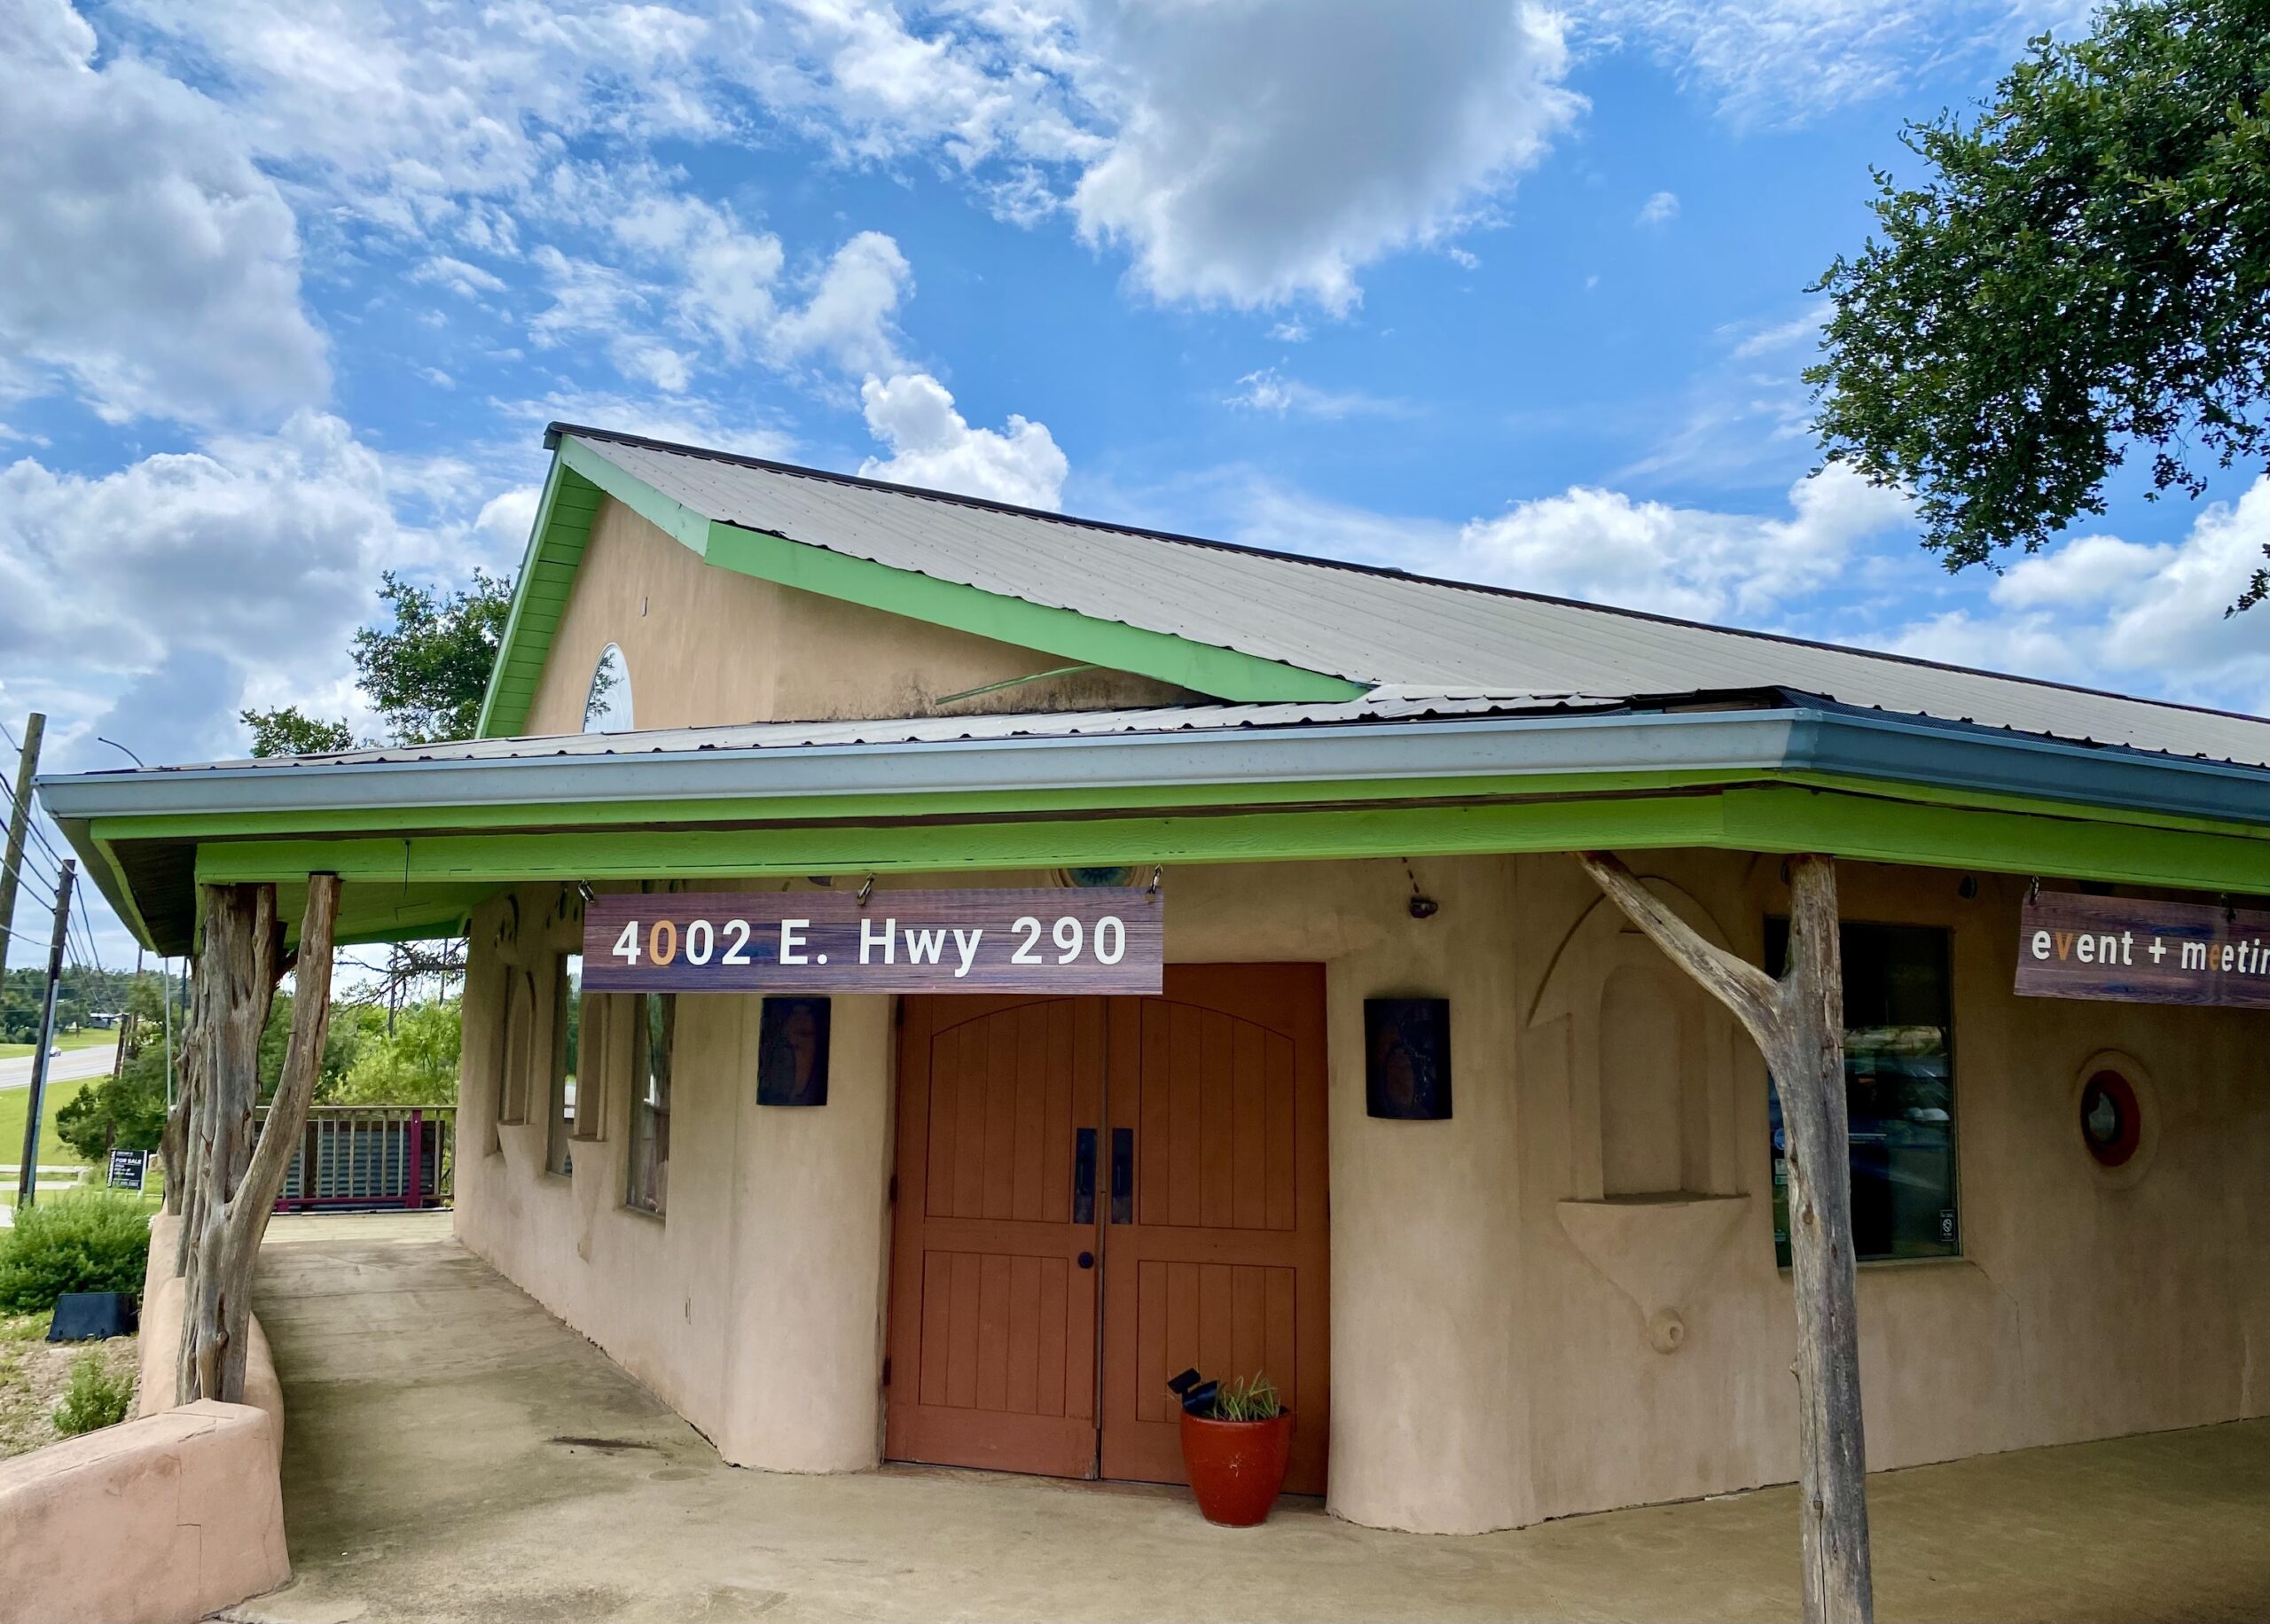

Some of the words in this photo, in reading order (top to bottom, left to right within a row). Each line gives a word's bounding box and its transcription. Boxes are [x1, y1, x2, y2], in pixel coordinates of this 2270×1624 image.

[613, 919, 751, 965] 4002
[779, 918, 828, 965] E.
[859, 917, 984, 978] Hwy
[1011, 916, 1126, 965] 290
[2031, 931, 2133, 965] event
[2149, 937, 2166, 964] +
